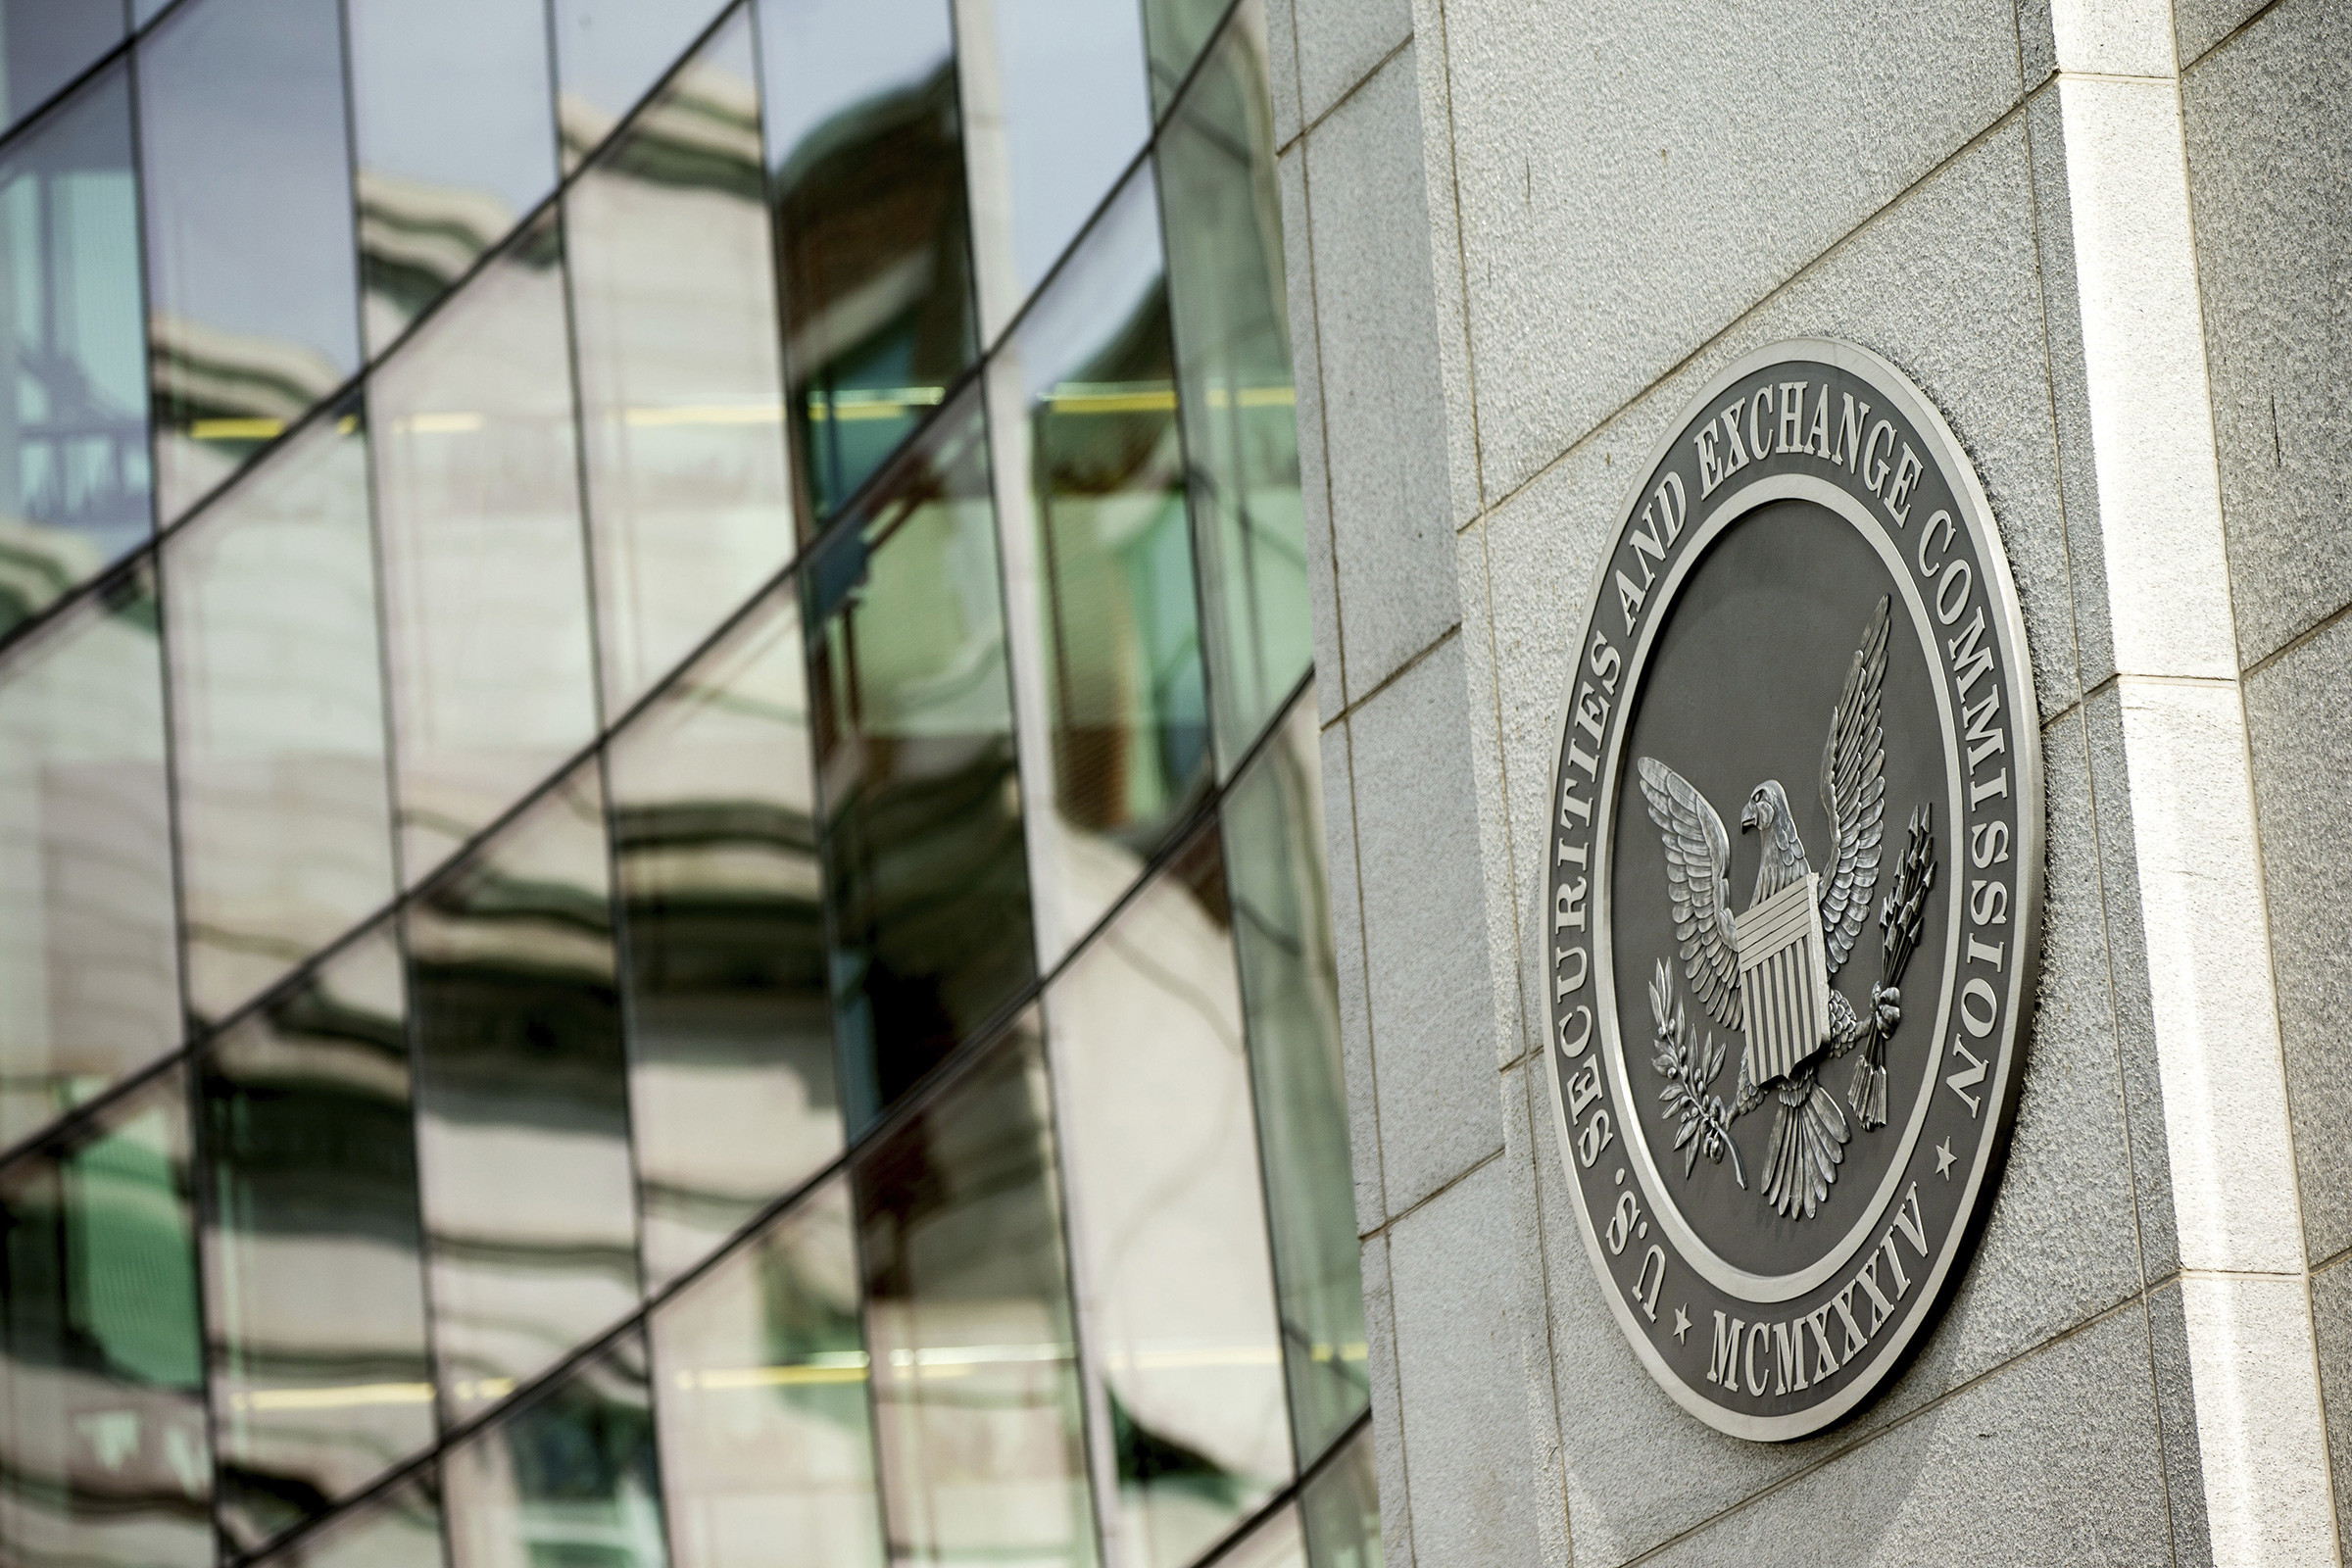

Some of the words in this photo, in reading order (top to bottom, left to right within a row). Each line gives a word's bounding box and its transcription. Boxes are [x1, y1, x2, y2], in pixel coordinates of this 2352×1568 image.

[1693, 380, 1924, 529] EXCHANGE
[1612, 470, 1687, 637] AND
[1555, 630, 1622, 1168] SECURITIES
[1918, 510, 2010, 1119] COMMISSION
[1605, 1168, 1668, 1323] U.S.
[1706, 1181, 1929, 1397] MCMXXXIV
